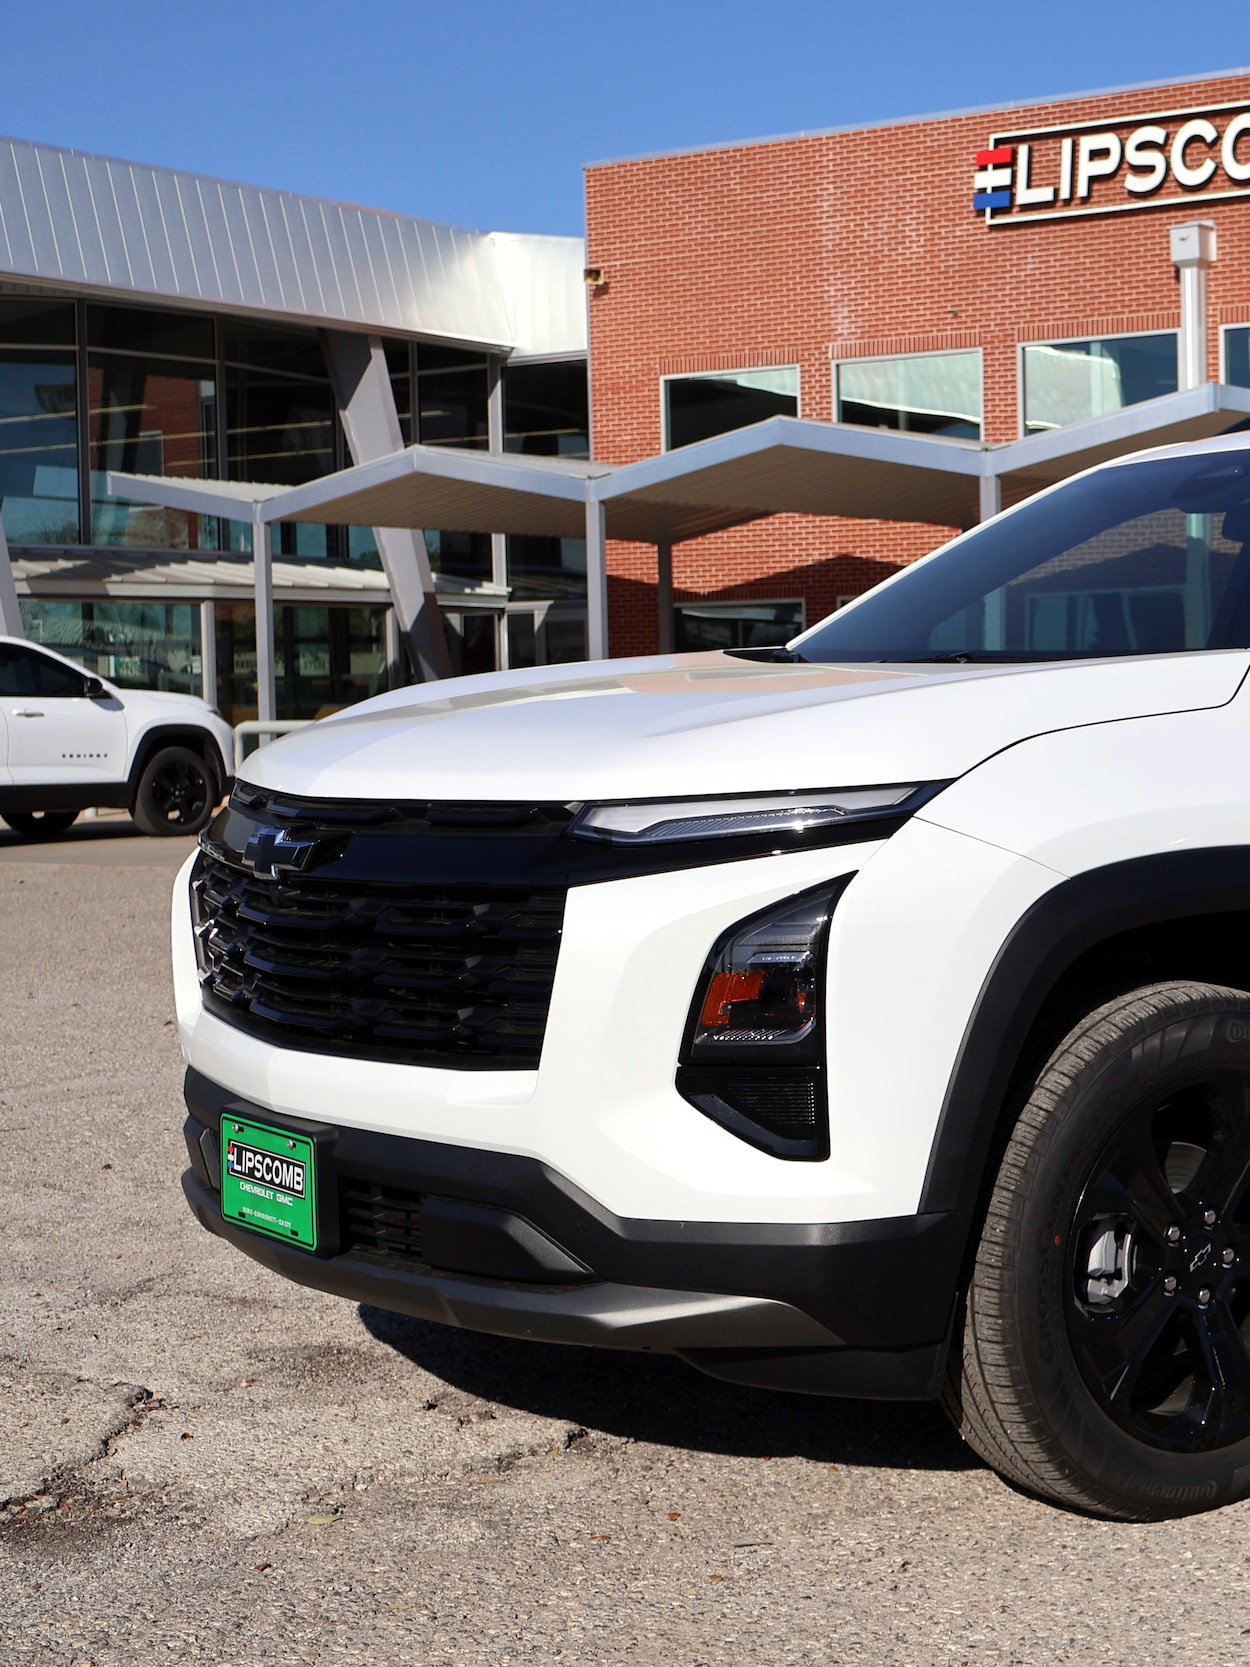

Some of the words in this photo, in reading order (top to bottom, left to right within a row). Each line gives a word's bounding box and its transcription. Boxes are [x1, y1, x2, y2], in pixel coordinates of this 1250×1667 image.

[233, 1146, 305, 1191] LIPSCOMB
[239, 1181, 274, 1200] CHEVROLET
[276, 1194, 294, 1207] GMC
